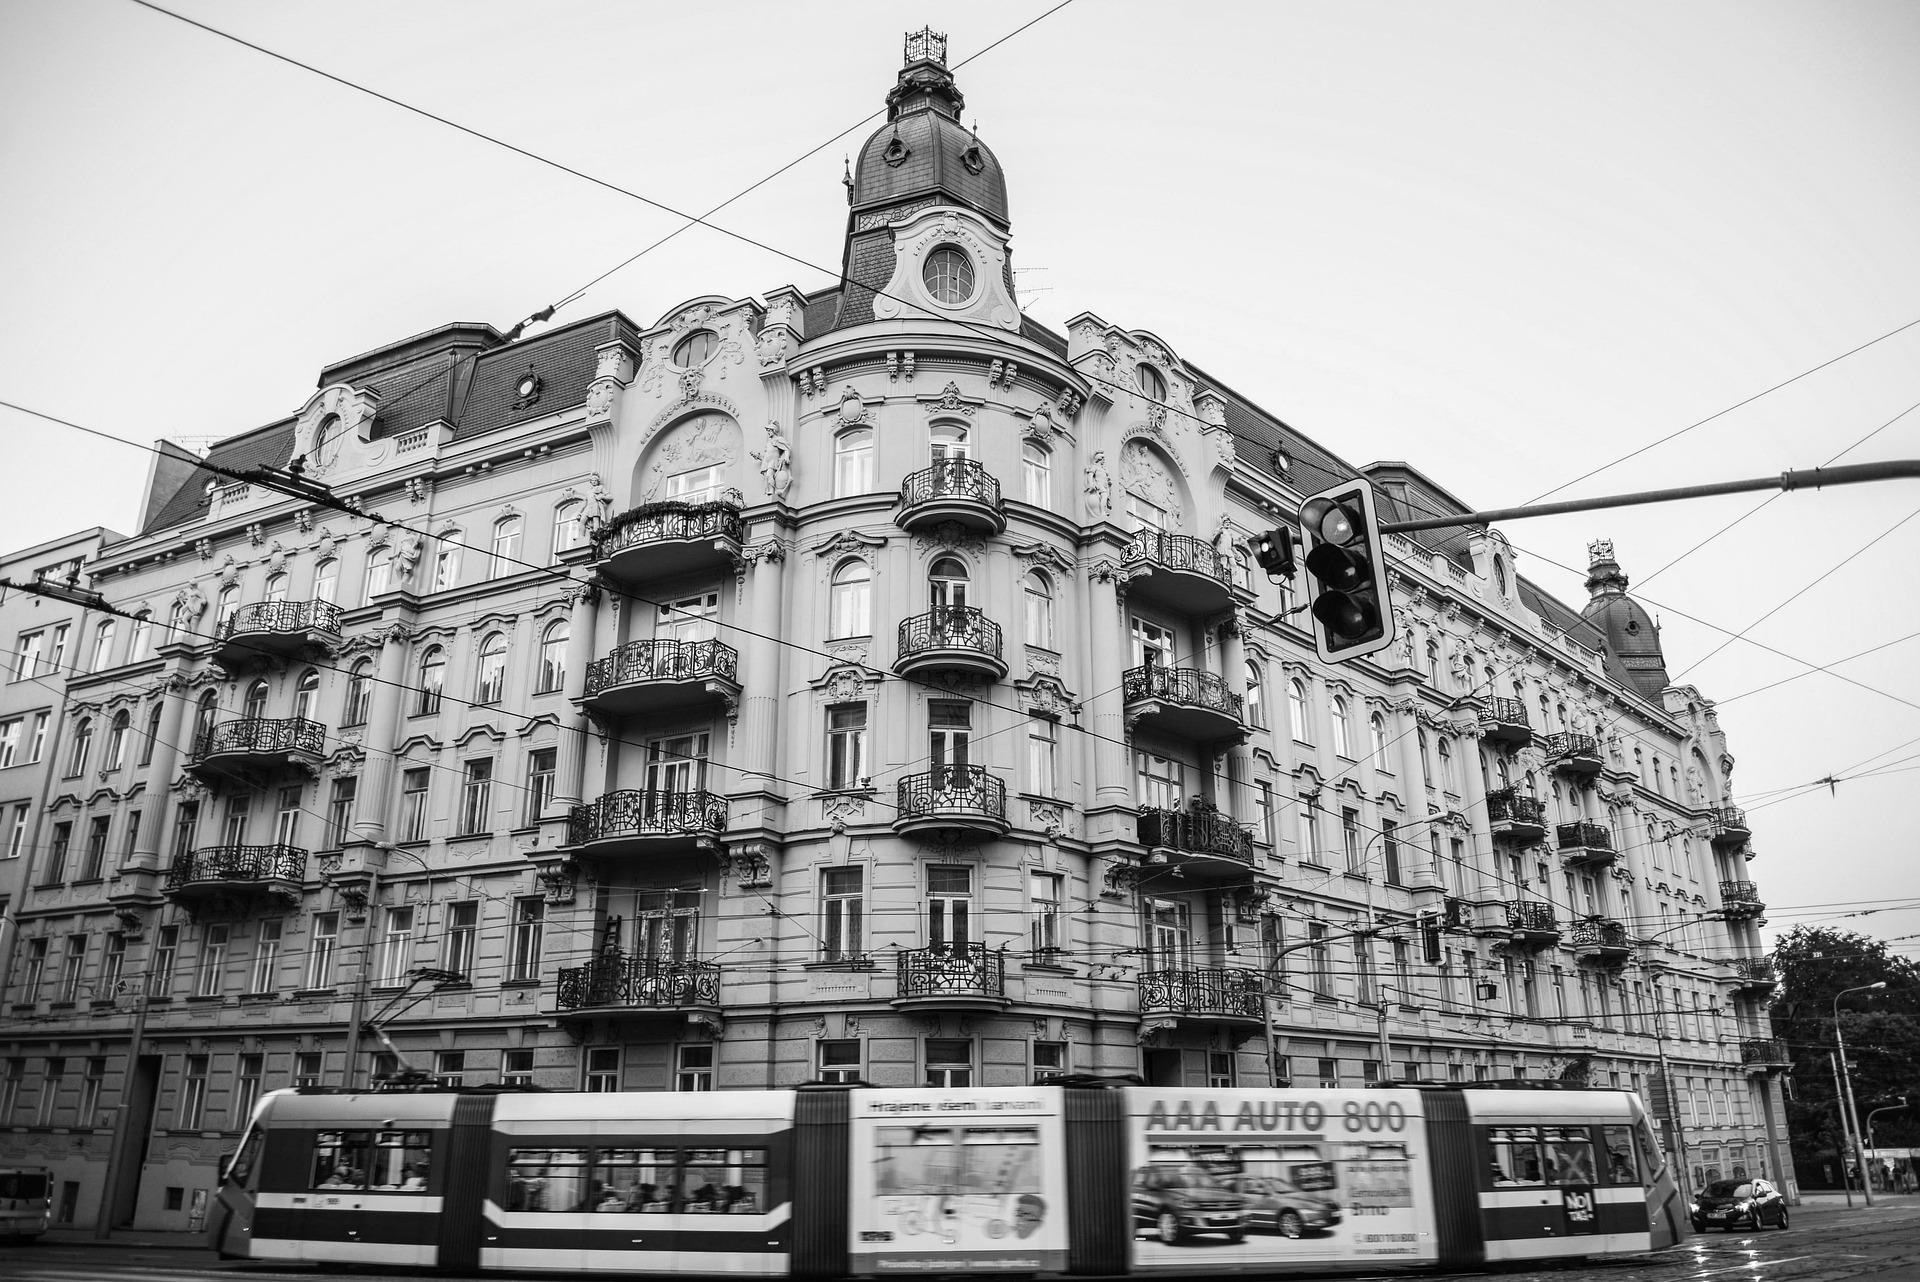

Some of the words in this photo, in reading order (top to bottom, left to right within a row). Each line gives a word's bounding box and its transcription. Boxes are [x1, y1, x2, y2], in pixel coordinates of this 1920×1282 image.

[1144, 1100, 1221, 1131] AAA
[1234, 1100, 1326, 1132] AUTO
[1343, 1100, 1406, 1133] 800
